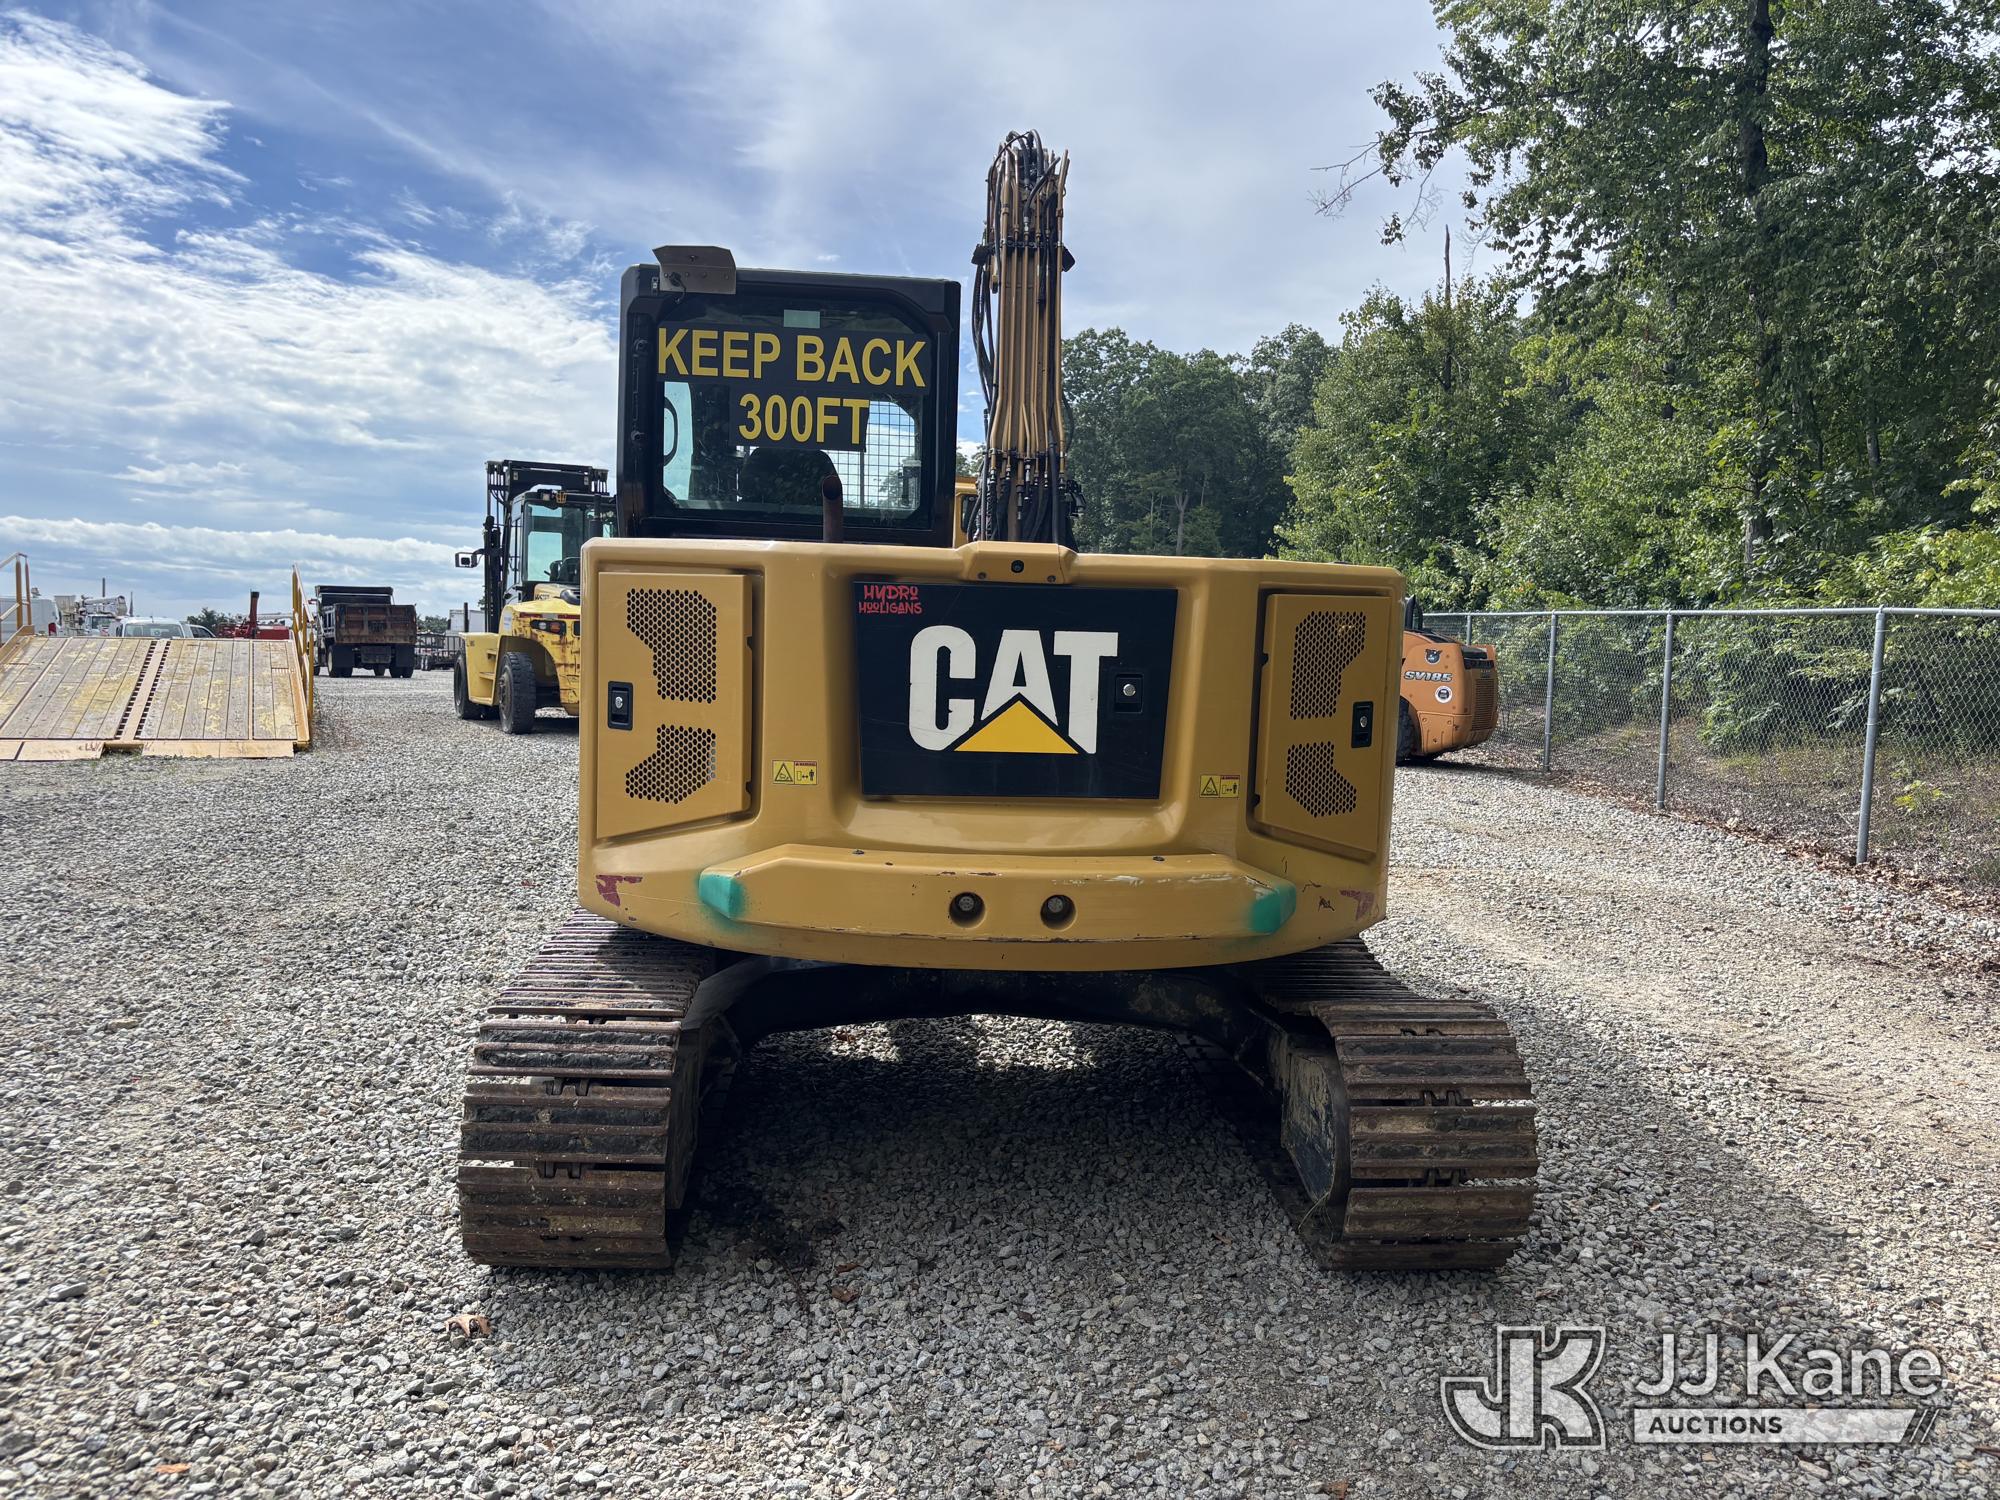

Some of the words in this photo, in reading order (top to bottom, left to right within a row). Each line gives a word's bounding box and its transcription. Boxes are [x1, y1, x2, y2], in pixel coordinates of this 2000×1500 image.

[658, 327, 781, 379] KEEP
[796, 335, 926, 387] BACK
[738, 393, 869, 444] 300FT
[858, 601, 922, 614] HOOLIGANS
[863, 584, 919, 605] HYDRO
[909, 625, 1119, 755] CAT
[1404, 671, 1452, 682] SV185
